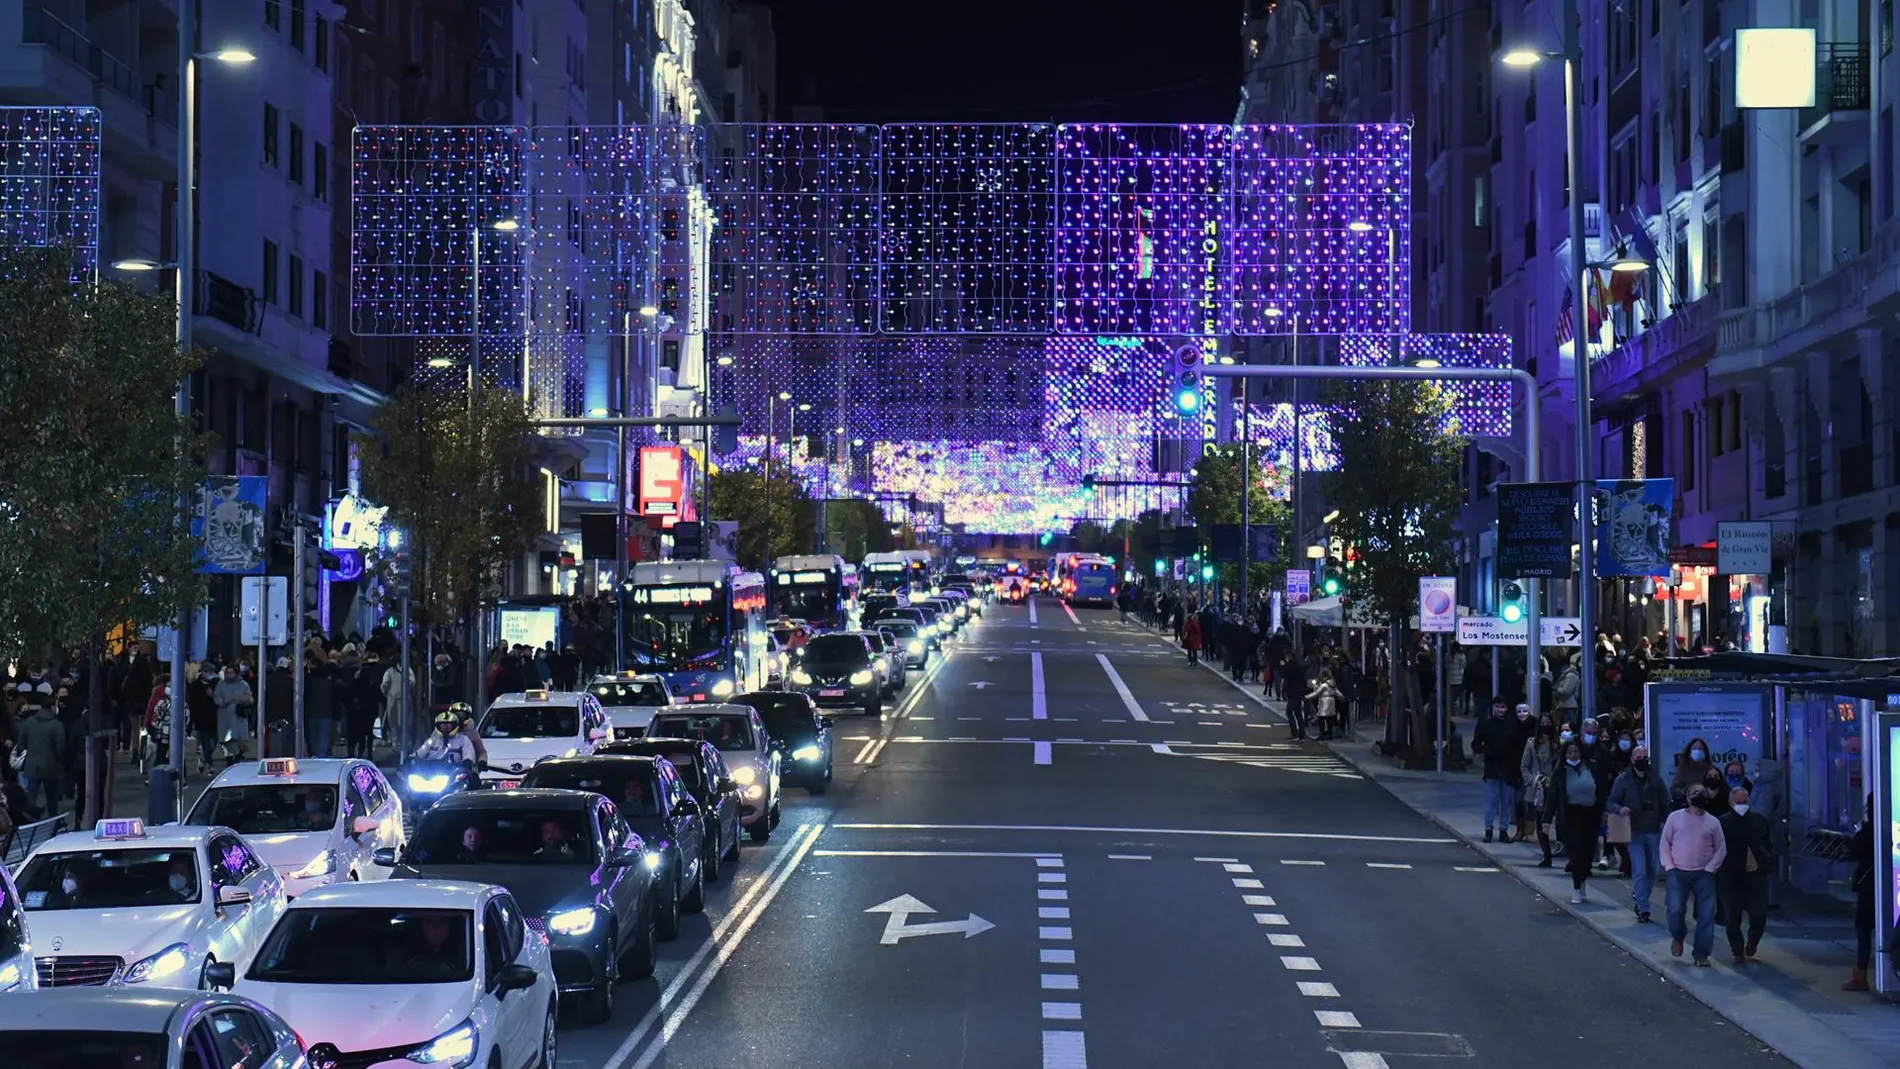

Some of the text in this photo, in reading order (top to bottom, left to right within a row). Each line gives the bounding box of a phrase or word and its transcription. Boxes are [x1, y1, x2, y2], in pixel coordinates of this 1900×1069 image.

[1203, 220, 1217, 309] HOTEL
[1721, 529, 1768, 538] El Rincón
[1721, 545, 1730, 553] de
[1732, 545, 1752, 553] Gran
[634, 589, 648, 603] 44
[1463, 620, 1493, 628] mercado
[1482, 632, 1528, 640] Mostenses
[1159, 701, 1245, 709] TAXI
[1171, 708, 1248, 716] BUS
[268, 763, 284, 772] TAXI
[106, 823, 127, 834] TAXI
